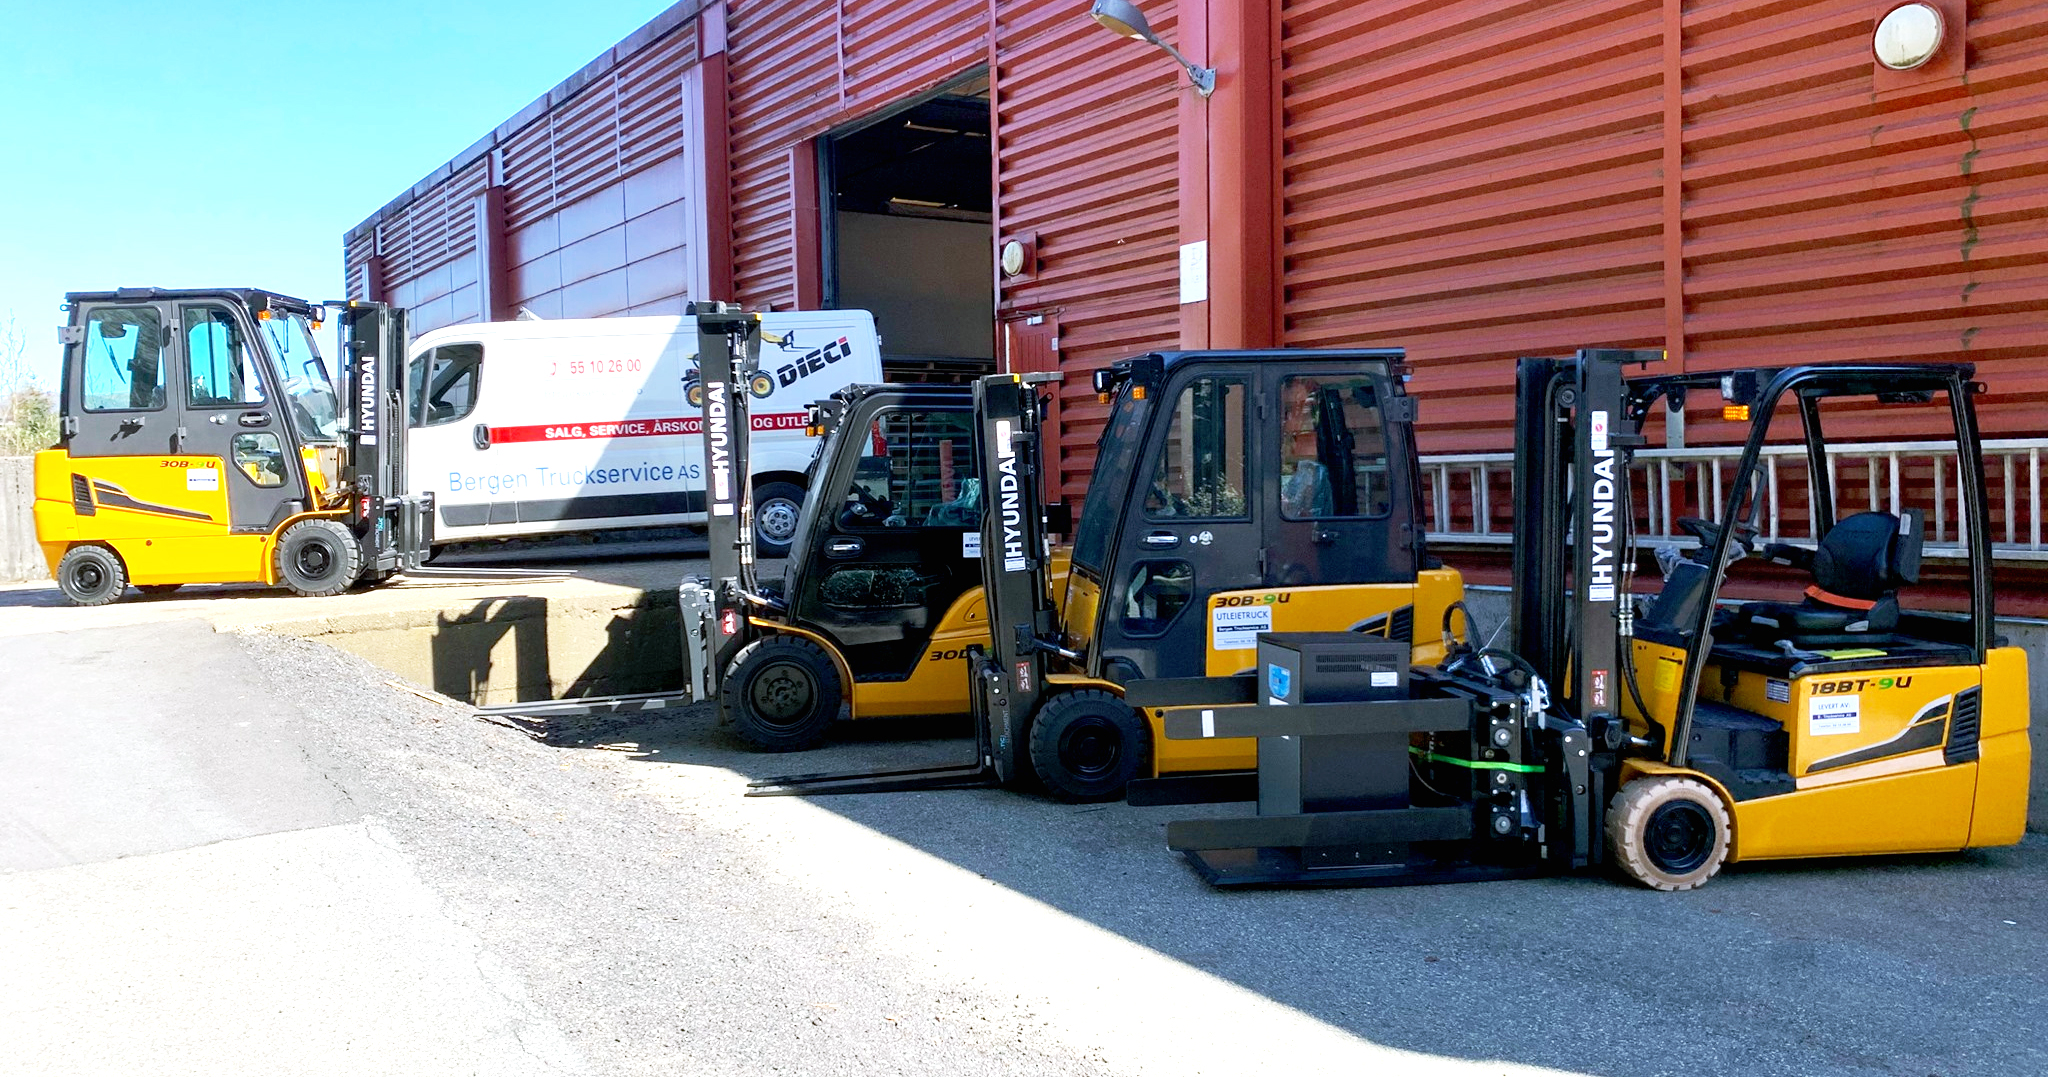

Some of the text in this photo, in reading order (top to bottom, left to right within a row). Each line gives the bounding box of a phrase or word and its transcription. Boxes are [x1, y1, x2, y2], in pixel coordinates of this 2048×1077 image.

[570, 358, 642, 374] 55 10 26 00
[361, 356, 375, 431] HYUNDAI
[545, 426, 587, 439] SALG,
[589, 423, 650, 437] SERVICE,
[753, 417, 773, 428] OG
[707, 381, 730, 474] HYUNDAI
[449, 462, 700, 495] Bergen Truckservice AS
[998, 451, 1023, 558] HYUNDAI
[1592, 450, 1615, 584] HYUNDAI
[1214, 593, 1291, 608] 30B-9U
[1216, 610, 1269, 621] UTLEIETRUCK
[1811, 676, 1913, 695] 18BT-9U
[1818, 702, 1839, 710] LEVERT
